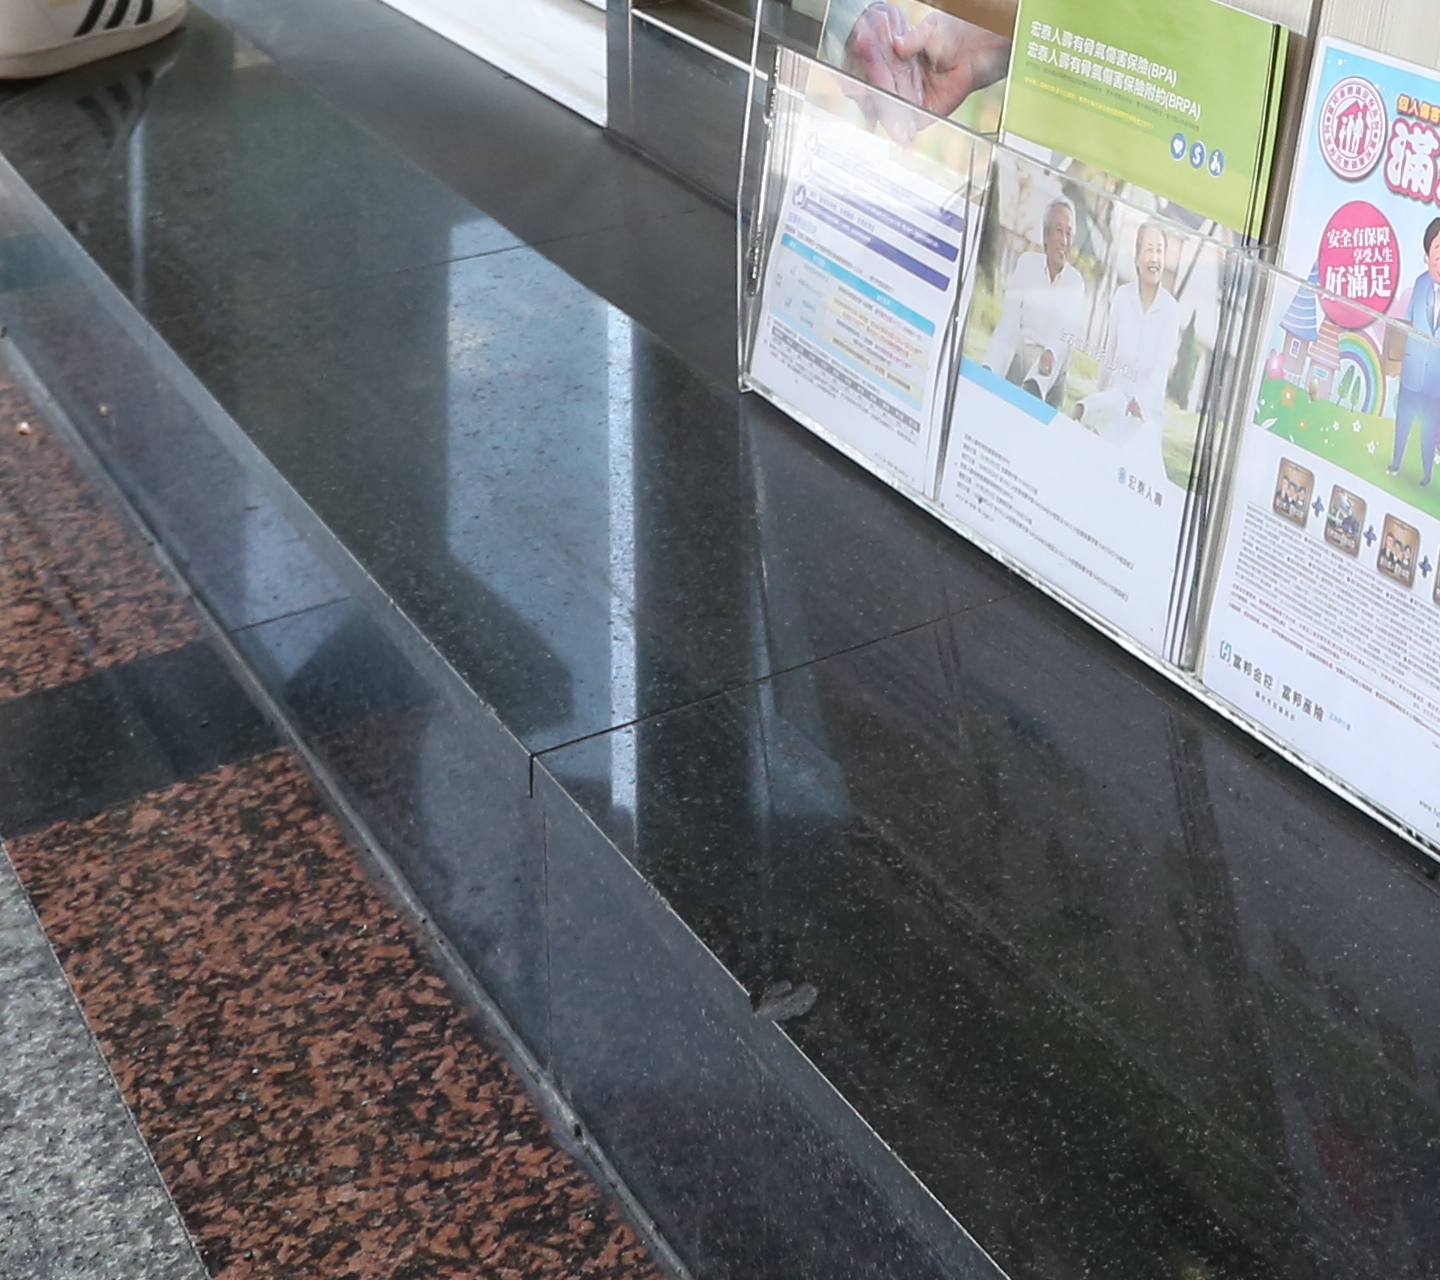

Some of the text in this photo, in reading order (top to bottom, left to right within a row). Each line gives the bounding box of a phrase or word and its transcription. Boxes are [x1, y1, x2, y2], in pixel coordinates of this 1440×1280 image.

[1326, 226, 1390, 249] 安全有保障
[1353, 245, 1393, 266] 享受人生
[1325, 262, 1393, 301] 好滿足
[1232, 650, 1325, 724] 富邦金控 富邦產險
